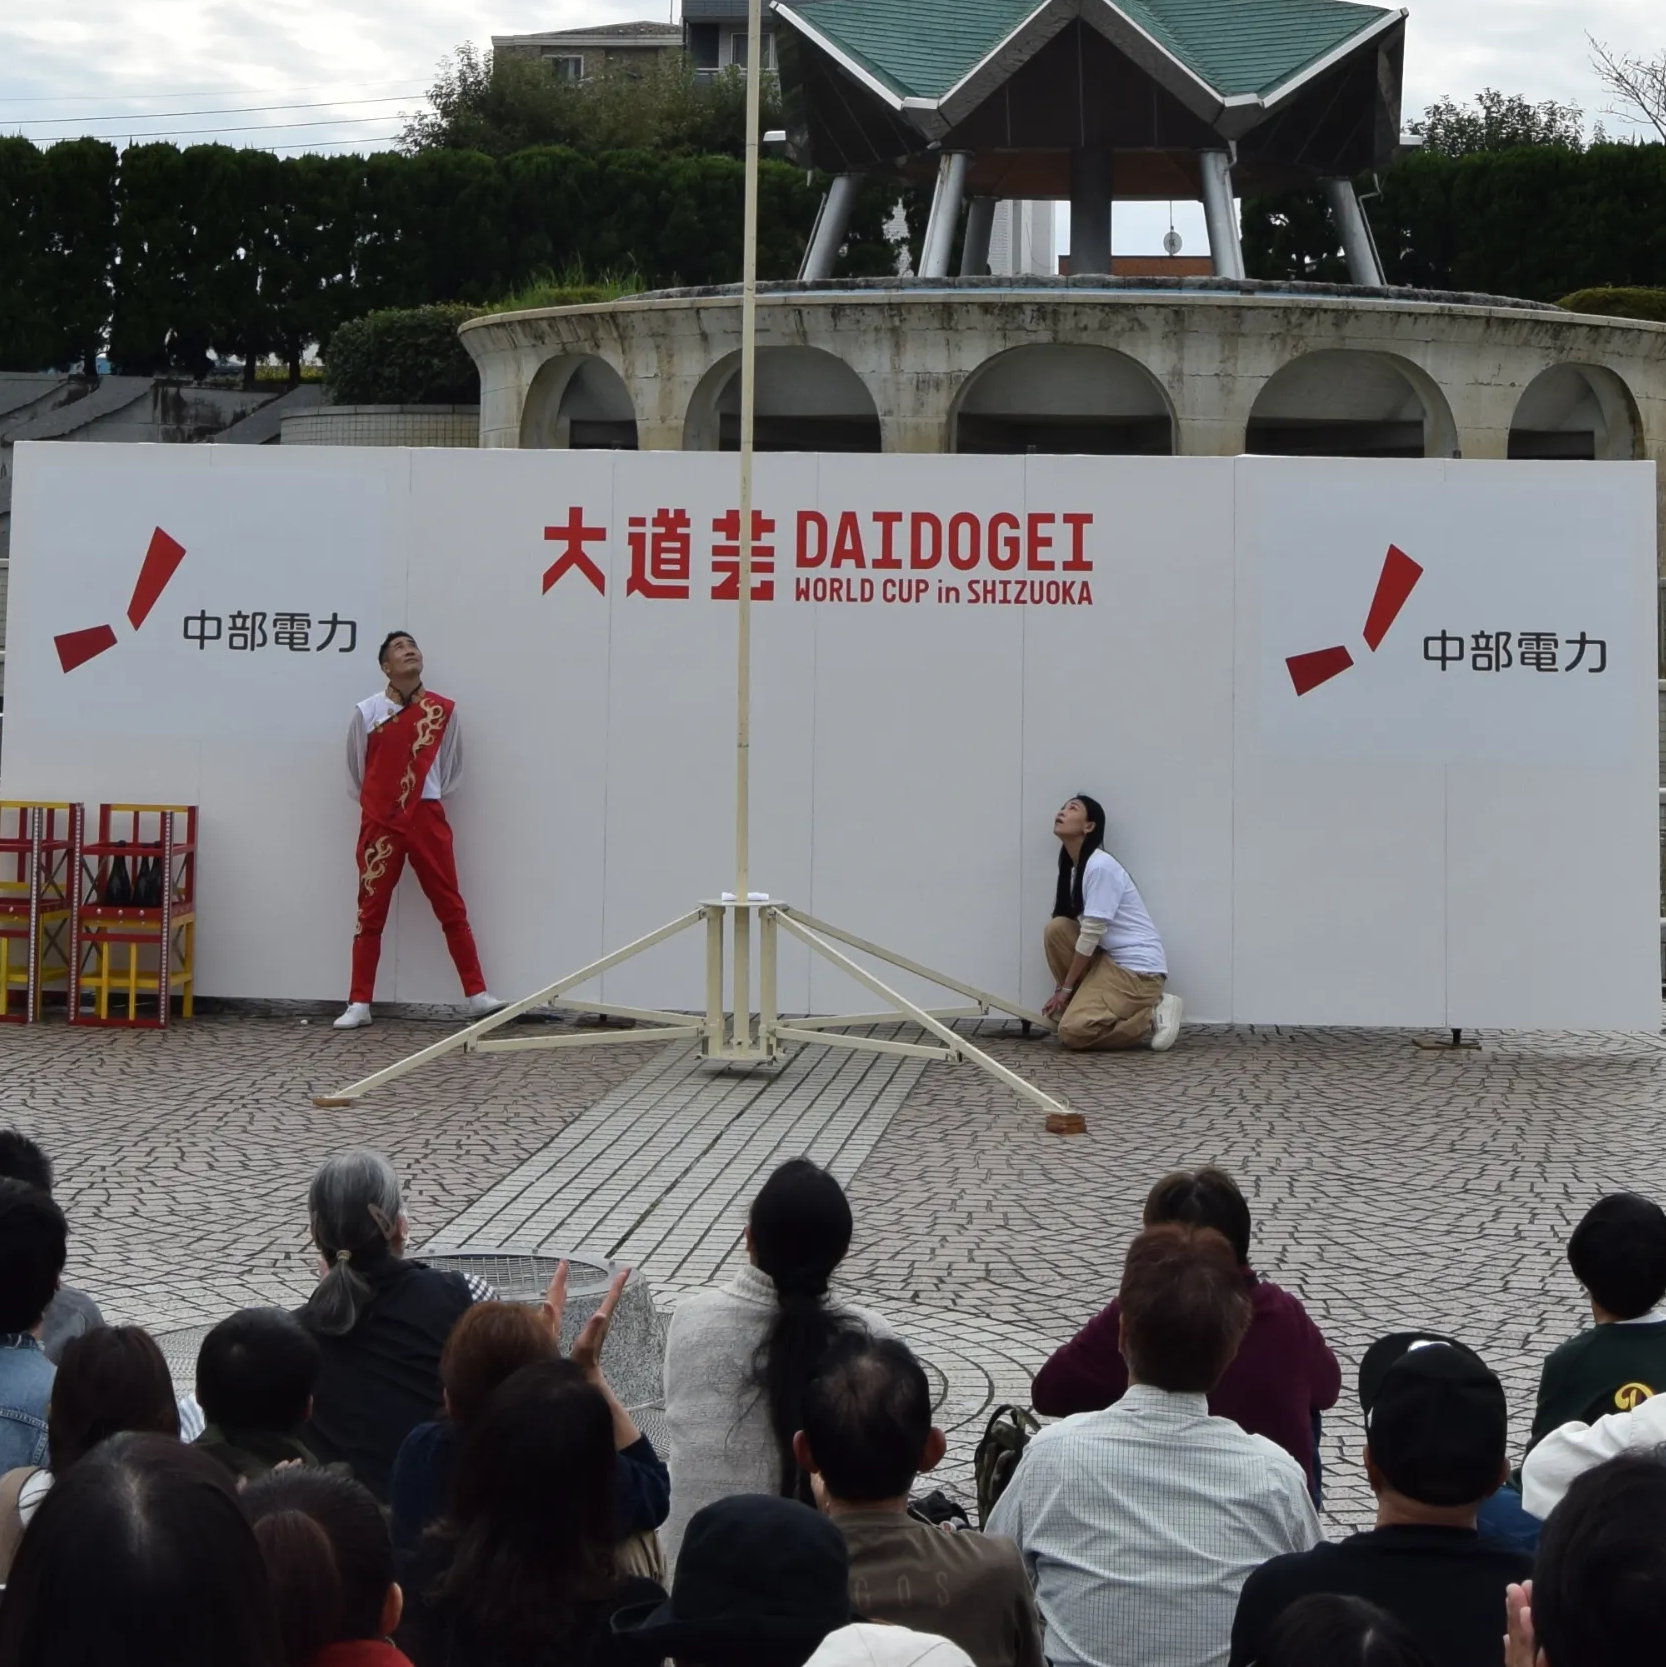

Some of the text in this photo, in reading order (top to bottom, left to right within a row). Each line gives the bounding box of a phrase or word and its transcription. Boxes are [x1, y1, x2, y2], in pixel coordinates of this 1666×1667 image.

[541, 506, 775, 602] 大道芸
[795, 510, 1094, 572] DAIDOGEI
[794, 576, 1094, 606] WORLD CUP in SHIZUOKA
[182, 608, 358, 654] 中部電力
[1422, 628, 1608, 674] 中部電力
